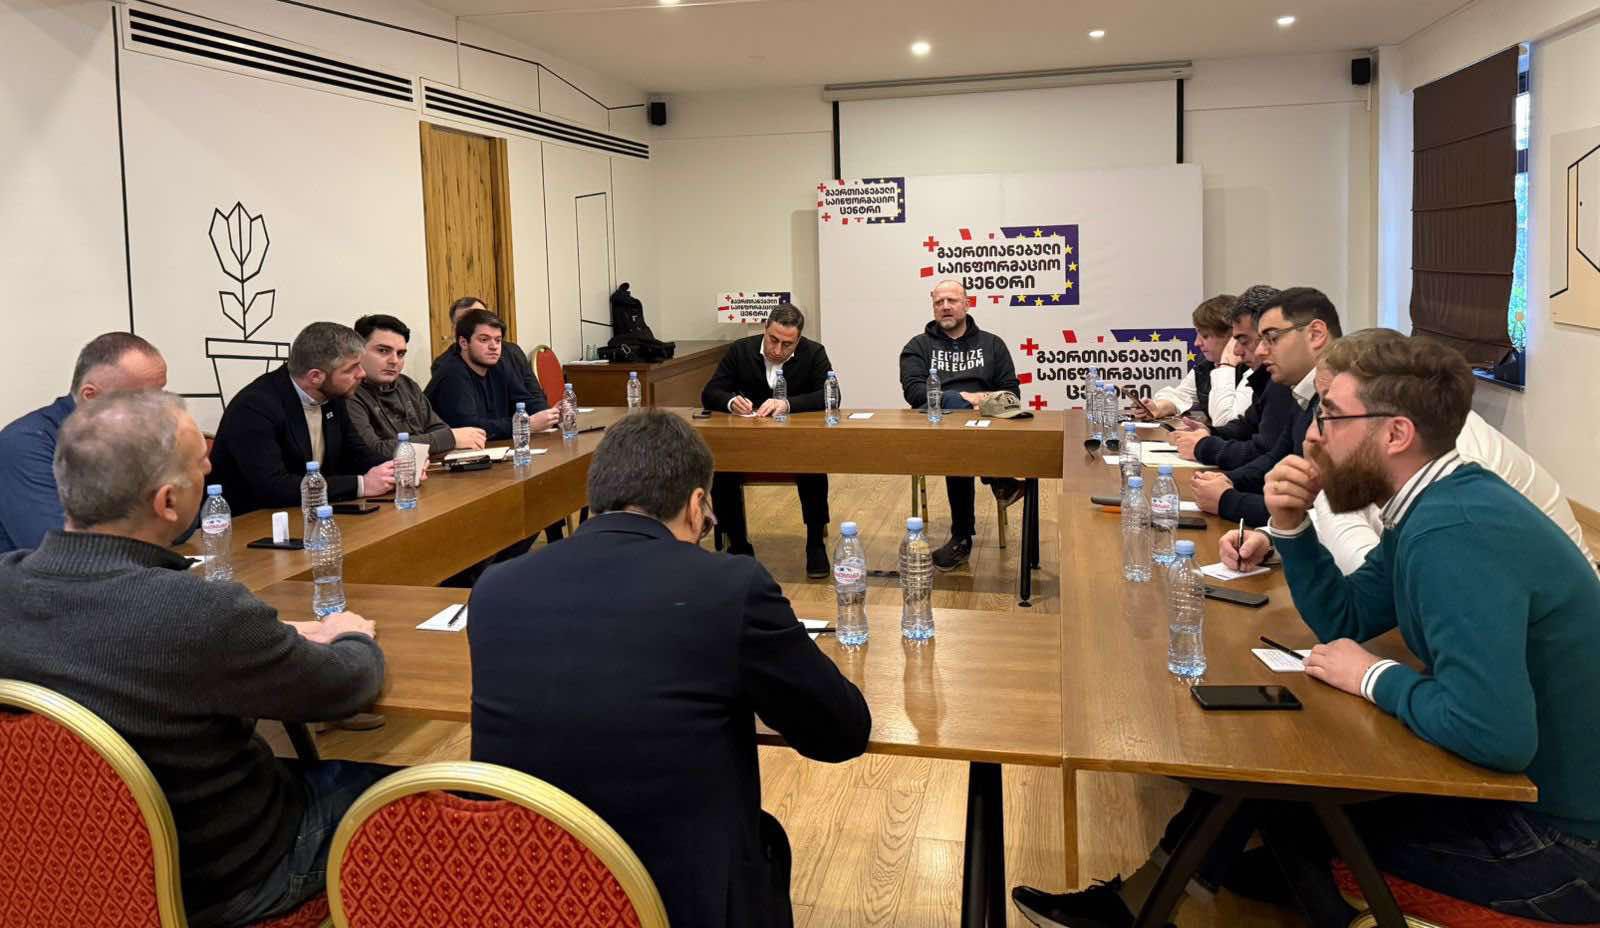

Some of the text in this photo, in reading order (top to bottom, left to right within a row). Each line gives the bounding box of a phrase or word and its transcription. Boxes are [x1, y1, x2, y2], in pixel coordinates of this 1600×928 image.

[825, 187, 895, 196] გაერთიანებული
[825, 196, 895, 205] საინფორმაციო
[840, 205, 881, 214] ცენტრი
[937, 243, 1060, 258] გაერთიანებული
[938, 259, 1060, 273] საინფორმაციო
[962, 275, 1035, 290] ცენტრი
[932, 348, 983, 362] LEGALIZE
[1036, 349, 1182, 364] გაერთიანებული
[931, 357, 985, 372] FREEDOM
